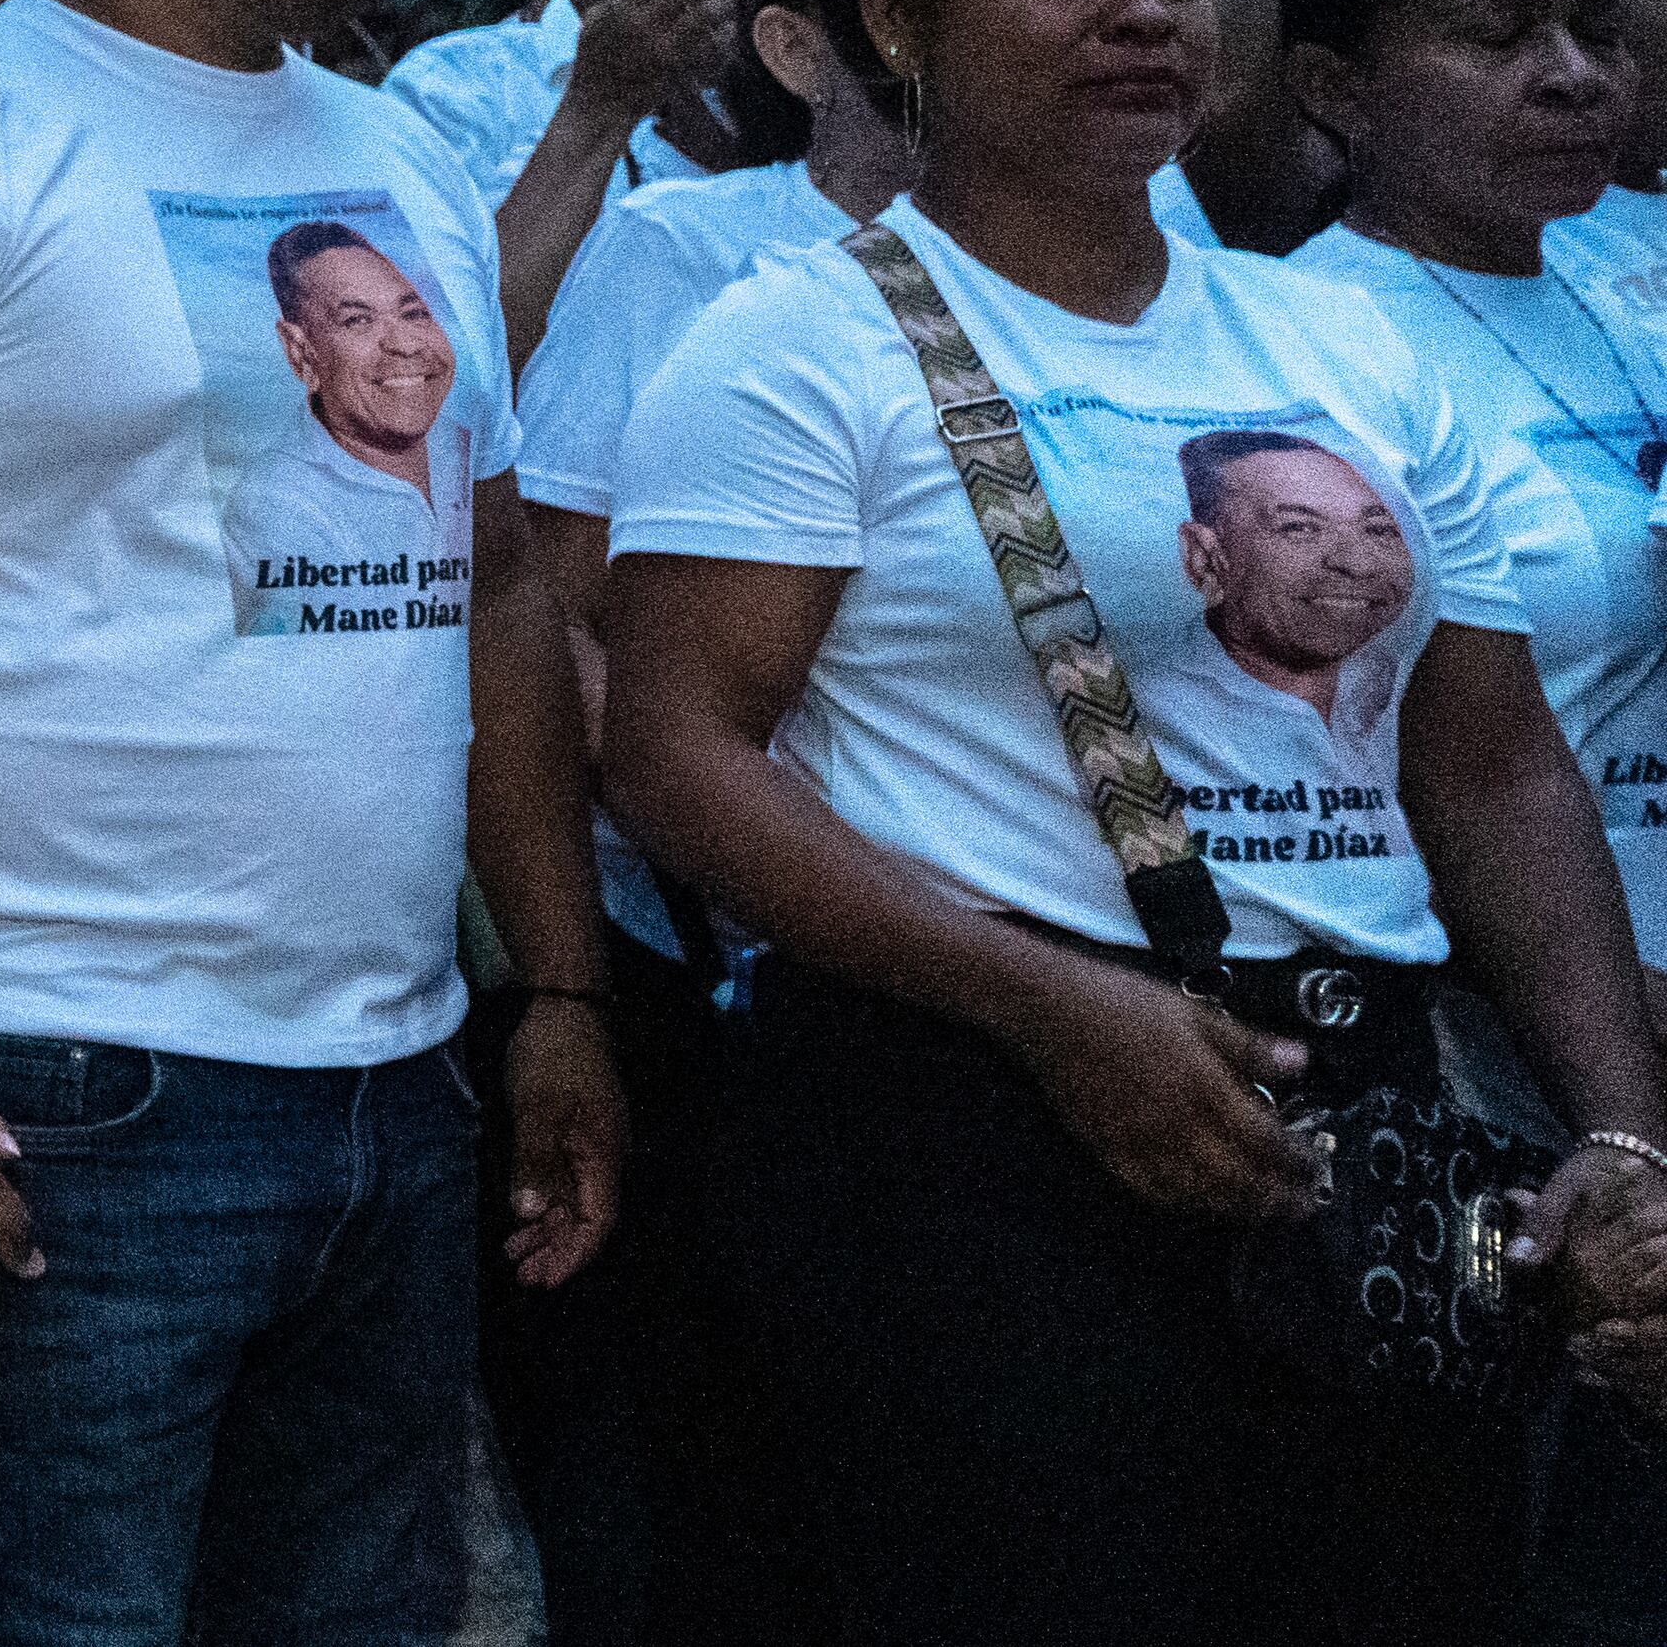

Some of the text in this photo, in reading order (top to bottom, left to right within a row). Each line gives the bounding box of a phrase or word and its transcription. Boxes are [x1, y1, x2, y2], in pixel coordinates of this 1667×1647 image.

[255, 554, 409, 589] Libertad
[299, 594, 462, 634] Mane Díaz
[1305, 825, 1391, 861] Díaz
